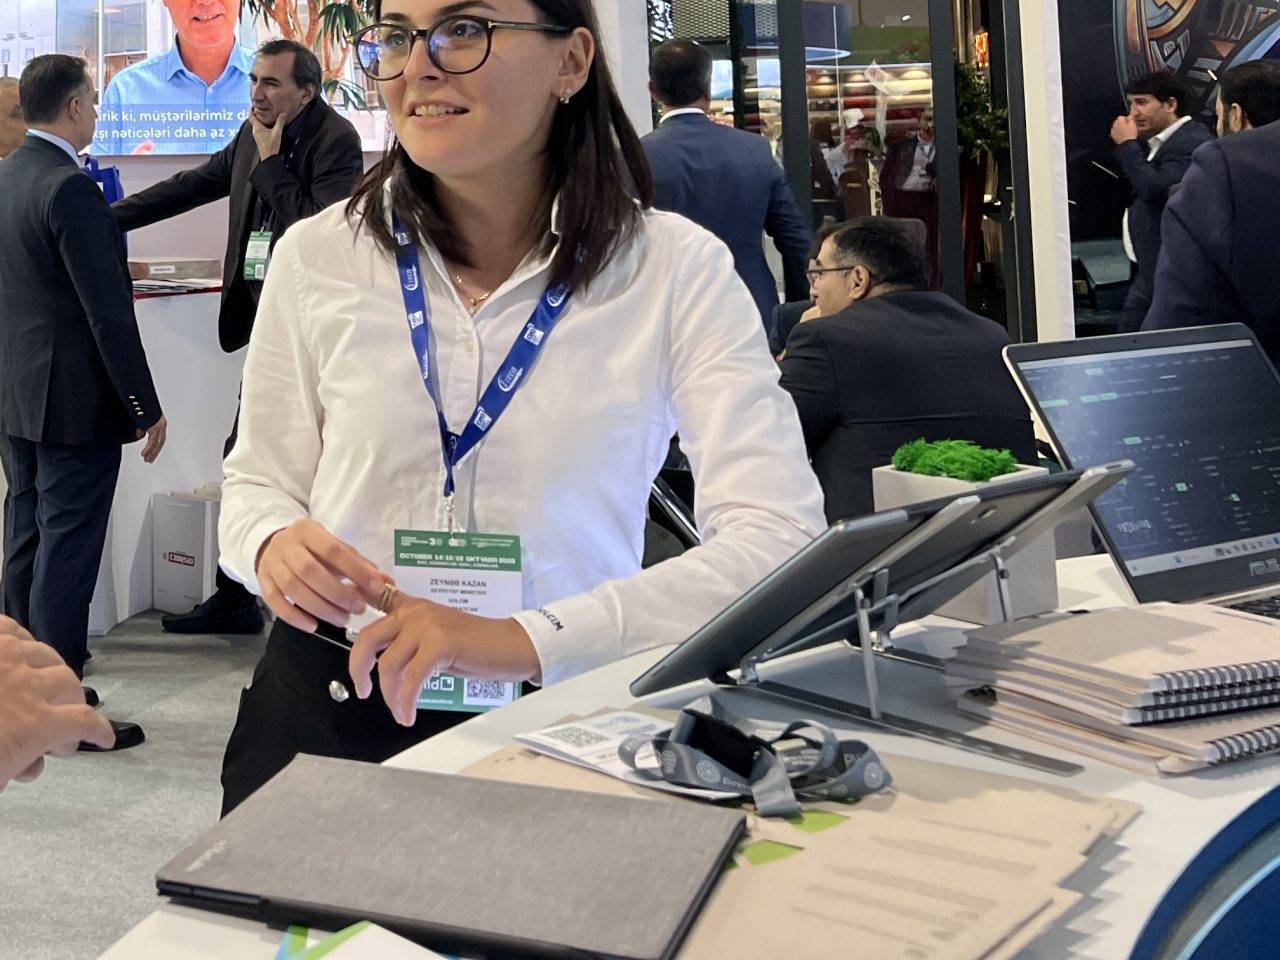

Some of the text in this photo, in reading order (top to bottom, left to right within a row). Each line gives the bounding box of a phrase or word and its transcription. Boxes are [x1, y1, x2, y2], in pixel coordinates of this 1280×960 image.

[122, 110, 136, 123] ki,
[140, 110, 234, 124] müştərilərimiz
[112, 127, 170, 138] nəticələri
[174, 126, 206, 138] daha
[210, 128, 224, 138] az
